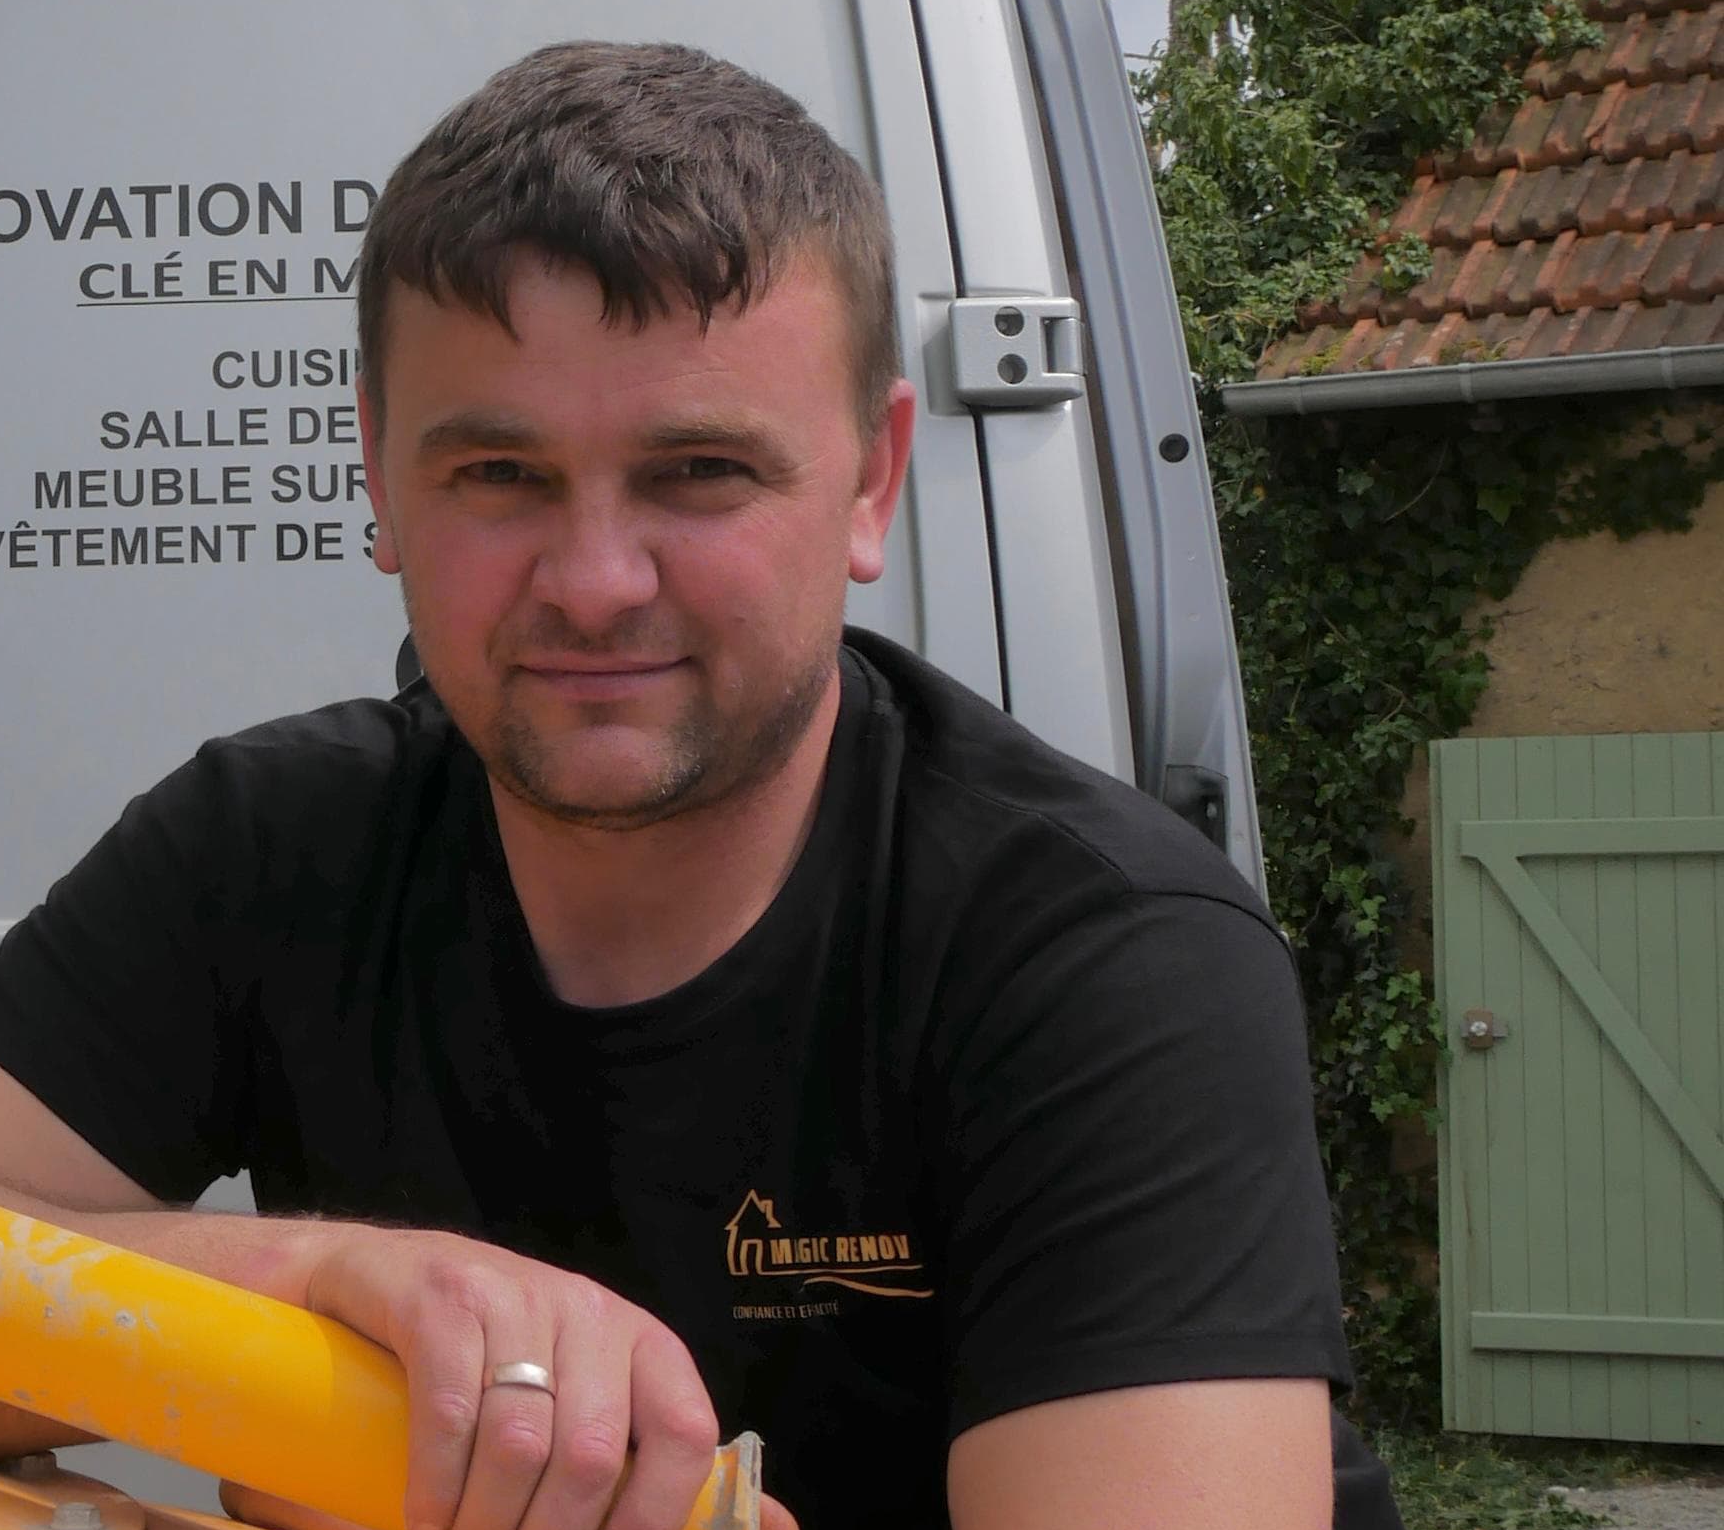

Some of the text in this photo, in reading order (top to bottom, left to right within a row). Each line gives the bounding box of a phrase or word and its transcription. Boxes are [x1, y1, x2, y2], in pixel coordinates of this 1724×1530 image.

[333, 179, 378, 233] D
[79, 251, 359, 300] CLÉ EN M
[212, 348, 360, 390] CUISI
[100, 406, 357, 449] SALLE DE
[34, 463, 366, 510] MEUBLE SUR
[276, 522, 343, 562] DE
[836, 1234, 911, 1263] RENOV
[732, 1305, 783, 1320] CONFIANCE
